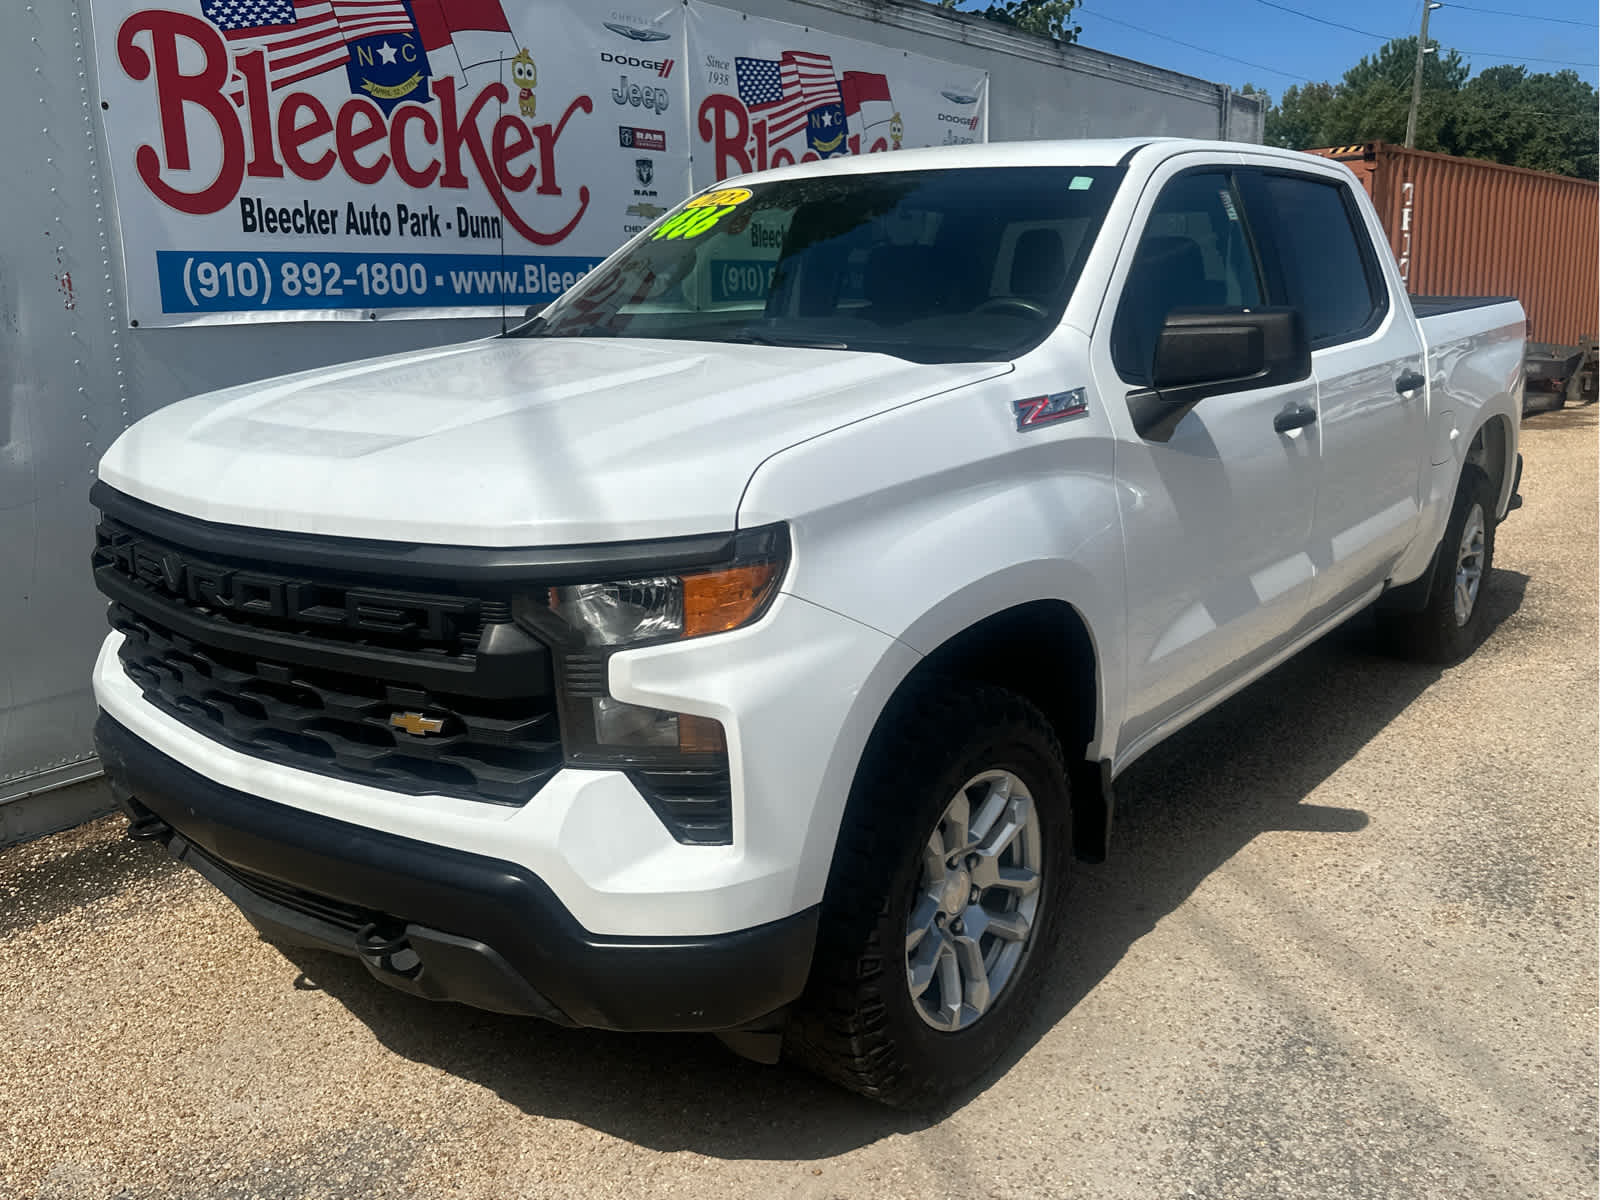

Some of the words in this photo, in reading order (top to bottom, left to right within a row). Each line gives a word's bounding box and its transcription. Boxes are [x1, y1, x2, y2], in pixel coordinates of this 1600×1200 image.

[601, 52, 666, 71] DODGE
[705, 56, 730, 71] Since
[708, 71, 729, 86] 1938
[612, 75, 670, 115] Jeep
[117, 10, 593, 246] Bleecker
[938, 113, 973, 126] DODGE
[635, 131, 664, 142] RAM
[633, 189, 658, 198] RAM
[240, 197, 338, 236] Bleecker
[345, 201, 392, 237] Auto
[396, 203, 442, 238] Park
[456, 206, 502, 240] Dunn
[183, 257, 272, 306] (910)
[281, 261, 427, 296] 892-1800
[450, 263, 593, 295] www.Bleec
[722, 263, 765, 297] (910)
[1017, 388, 1087, 427] Z71
